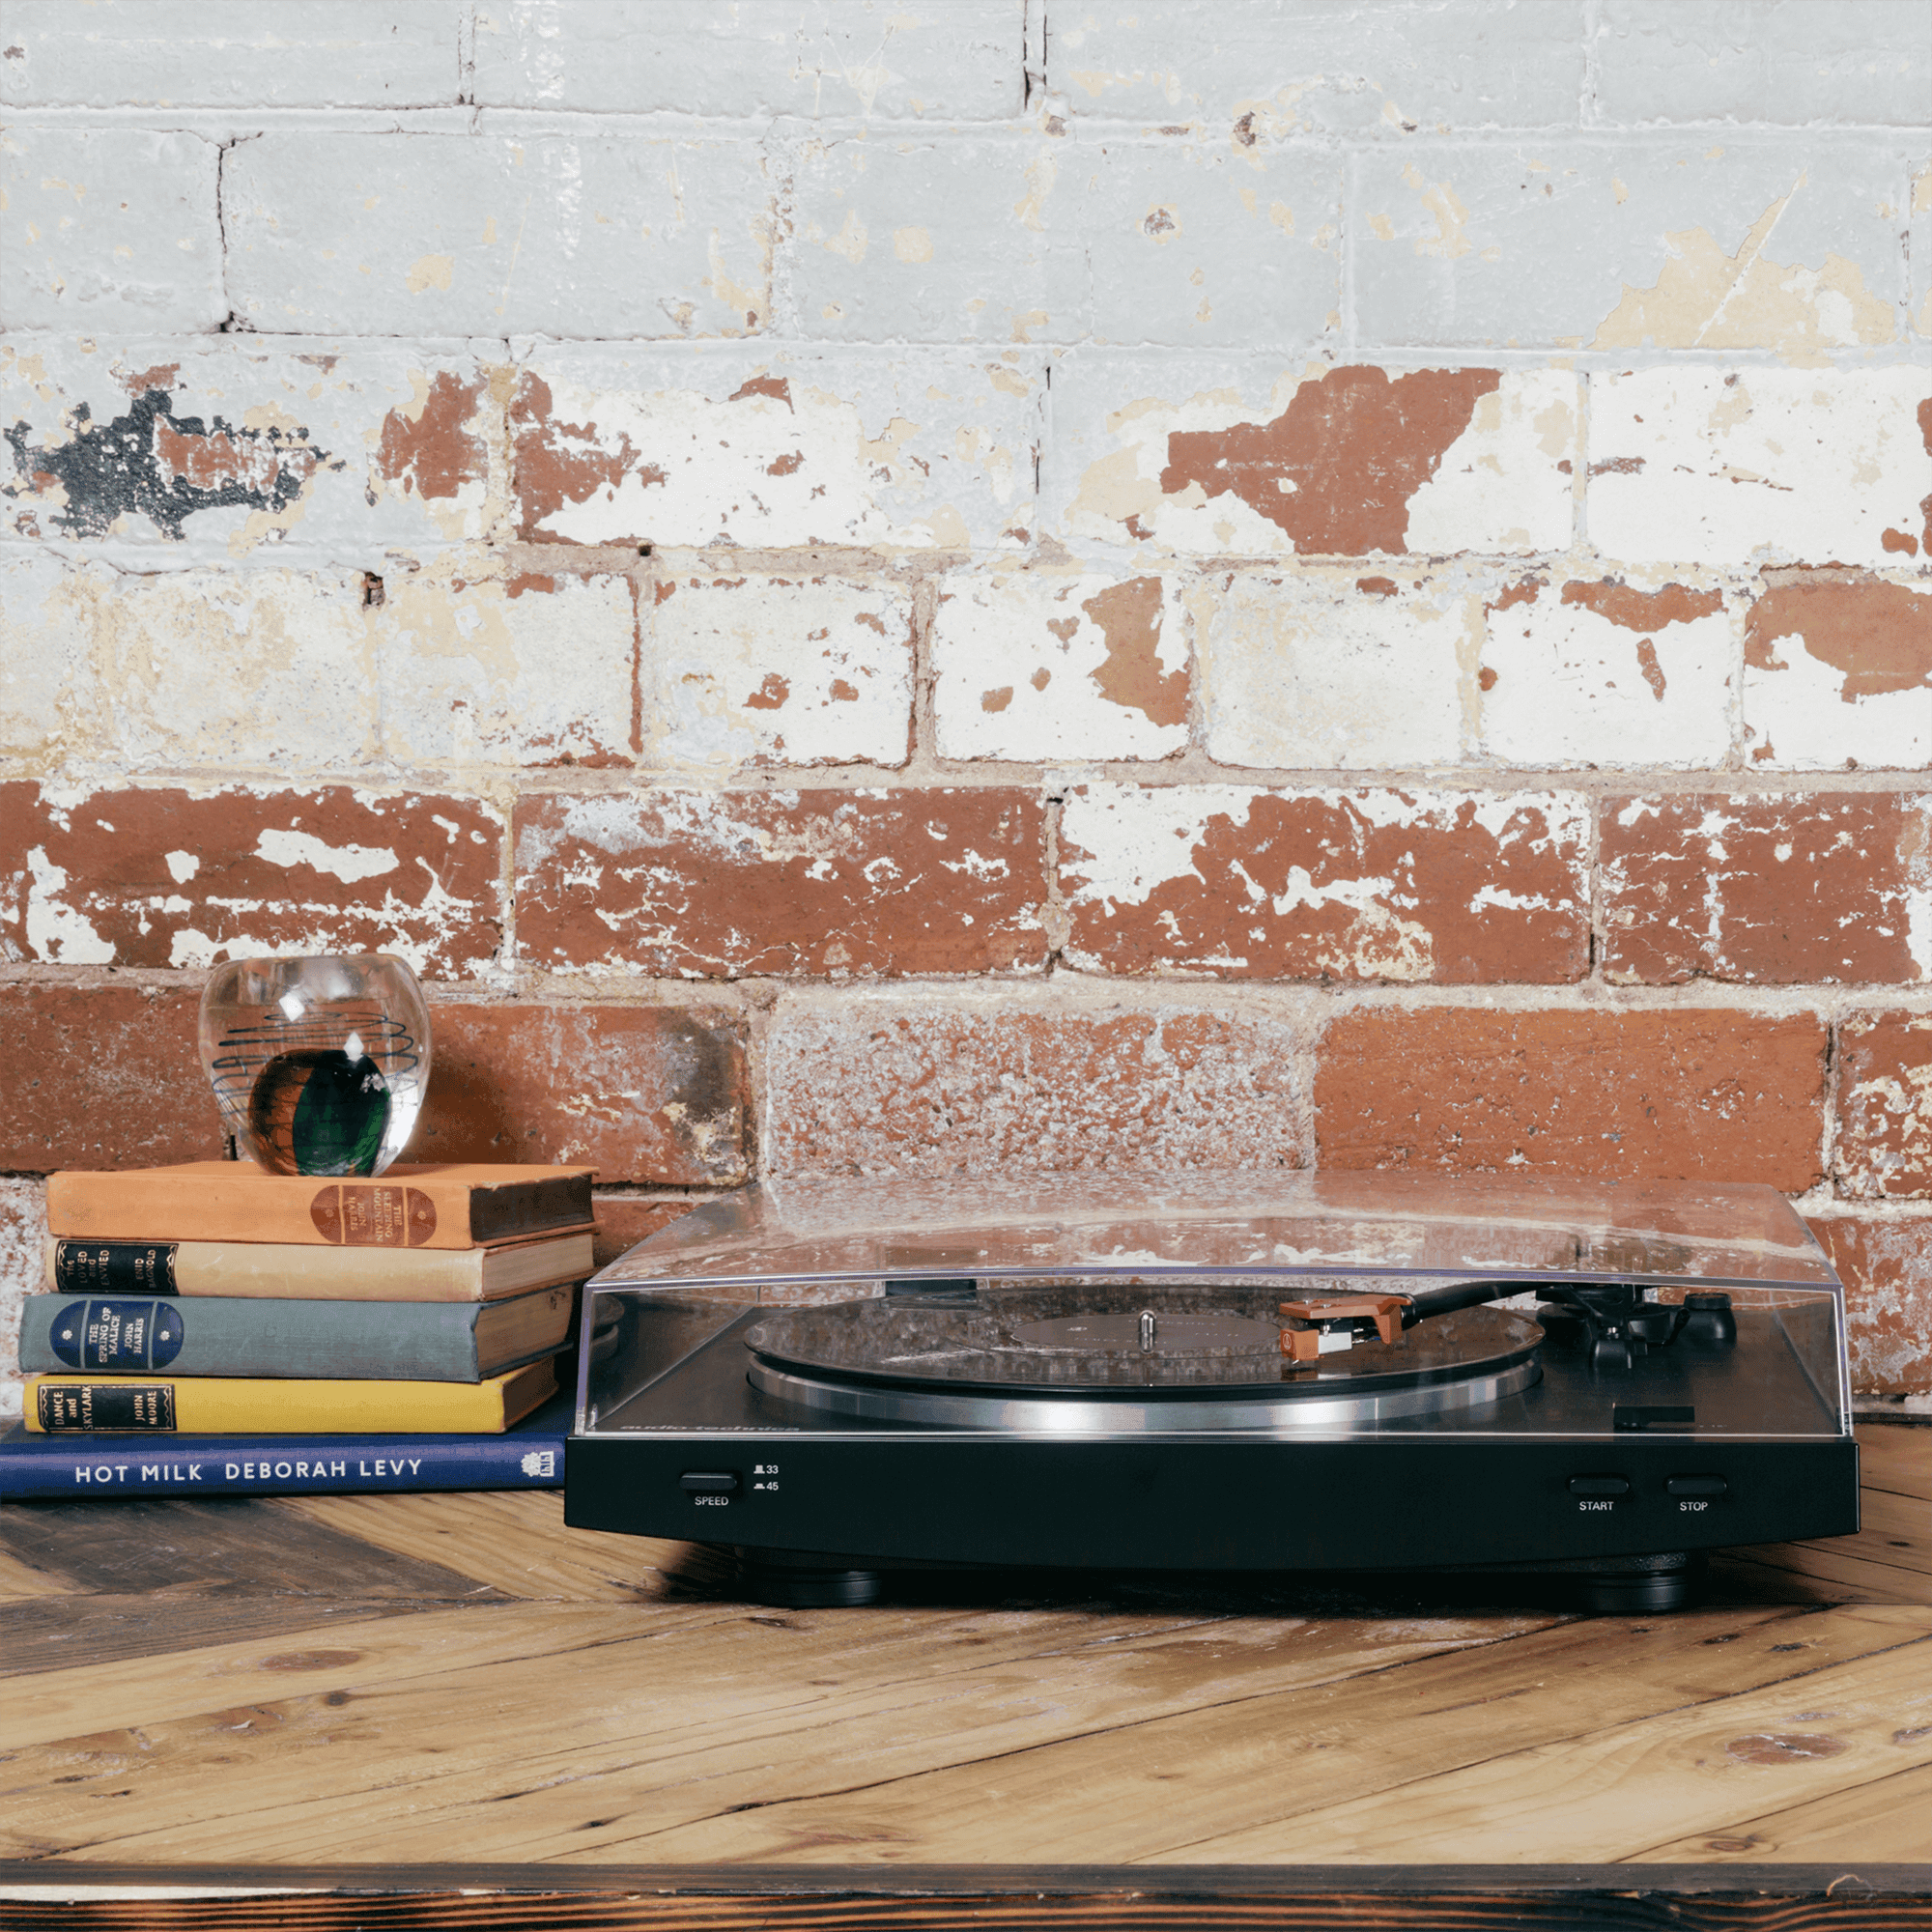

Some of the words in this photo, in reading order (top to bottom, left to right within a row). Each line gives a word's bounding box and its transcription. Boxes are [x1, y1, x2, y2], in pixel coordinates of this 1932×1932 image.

[348, 1196, 358, 1232] HARRIS
[356, 1202, 366, 1227] JOHN
[374, 1187, 384, 1242] MOUNTAIN
[384, 1191, 393, 1238] SLEEPING
[393, 1205, 403, 1227] THE
[67, 1260, 75, 1276] The
[77, 1251, 88, 1284] LOVED
[88, 1259, 97, 1277] and
[99, 1249, 110, 1286] ENVIED
[135, 1258, 144, 1280] ENID
[146, 1249, 156, 1288] BAGNOLD
[101, 1307, 112, 1321] OF
[89, 1323, 99, 1345] THE
[99, 1324, 109, 1363] SPRING
[109, 1315, 121, 1355] MALICE
[125, 1322, 134, 1349] JOHN
[133, 1318, 145, 1354] HARRIS
[53, 1391, 65, 1425] DANCE
[67, 1398, 77, 1418] and
[81, 1385, 93, 1430] SKYLARK
[133, 1394, 146, 1421] JOHN
[147, 1391, 157, 1425] MOORE
[75, 1465, 128, 1483] HOT
[141, 1463, 203, 1481] MILK
[225, 1461, 346, 1480] DEBORAH
[359, 1459, 422, 1477] LEVY
[766, 1464, 779, 1474] 33
[766, 1482, 779, 1491] 45
[695, 1496, 729, 1506] SPEED
[1578, 1501, 1614, 1511] START
[1679, 1501, 1708, 1511] STOP
